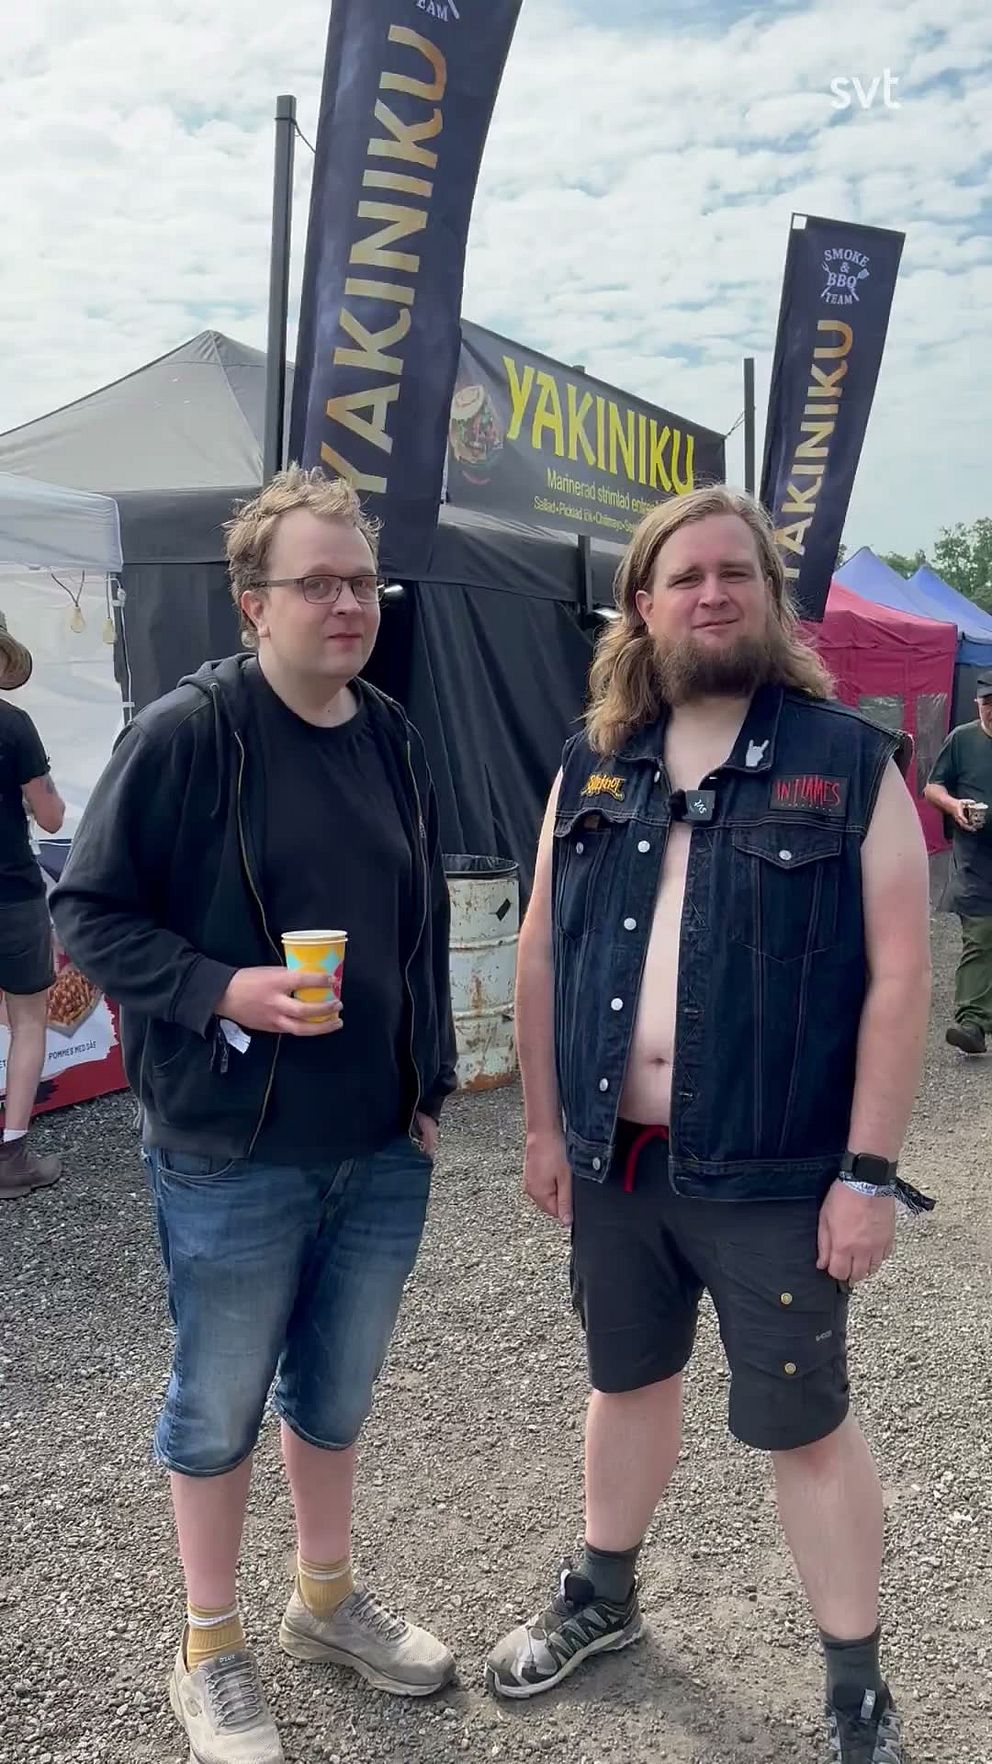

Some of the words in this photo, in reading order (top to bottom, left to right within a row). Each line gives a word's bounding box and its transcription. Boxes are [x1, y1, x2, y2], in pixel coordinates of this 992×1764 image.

[321, 24, 448, 494] YAKINIKU
[824, 248, 870, 268] SMOKE
[840, 261, 850, 273] &
[826, 271, 857, 290] BBQ
[825, 290, 853, 305] TEAM
[502, 354, 695, 496] YAKINIKU
[546, 467, 596, 501] Marinerad
[597, 483, 630, 509] strimlad
[48, 1046, 74, 1061] POMMES
